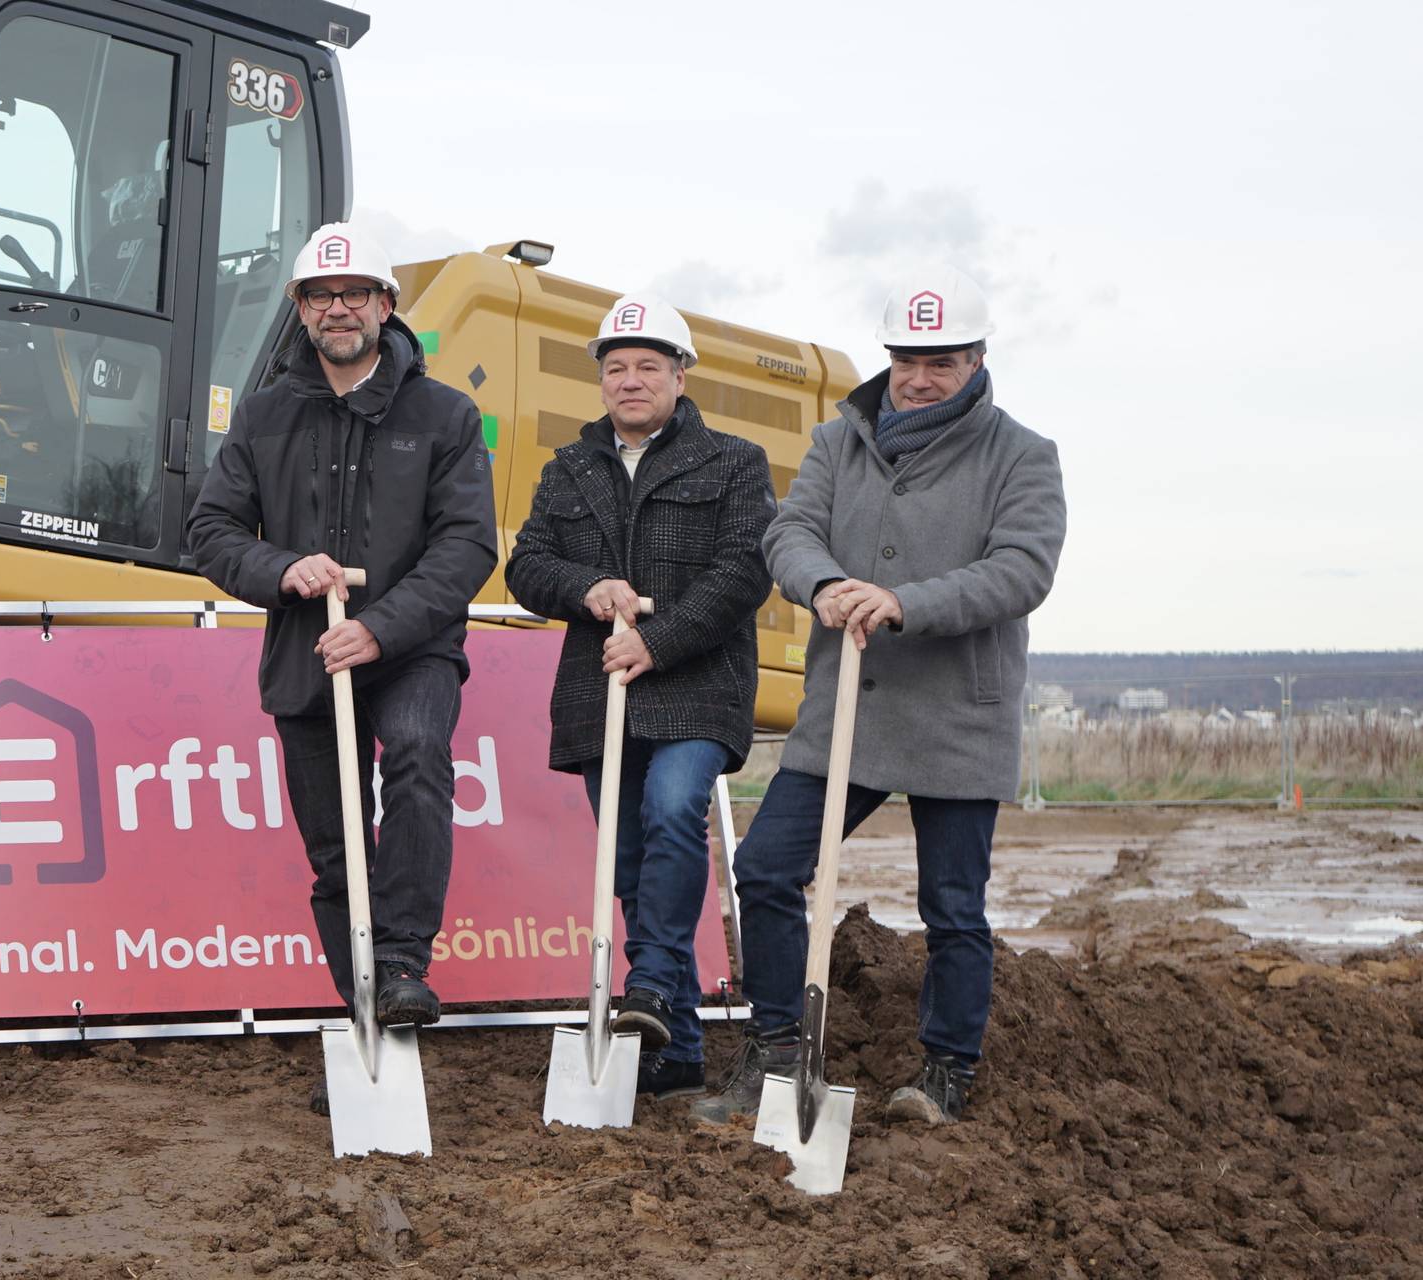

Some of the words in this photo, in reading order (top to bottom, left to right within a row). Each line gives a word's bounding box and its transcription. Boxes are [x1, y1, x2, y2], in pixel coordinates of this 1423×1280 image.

[229, 61, 286, 114] 336
[325, 243, 342, 260] E
[621, 309, 638, 325] E
[917, 301, 934, 322] E
[756, 354, 807, 377] ZEPPELIN
[20, 510, 99, 538] ZEPPELIN
[115, 924, 328, 971] Modern.
[431, 915, 594, 962] sönlich
